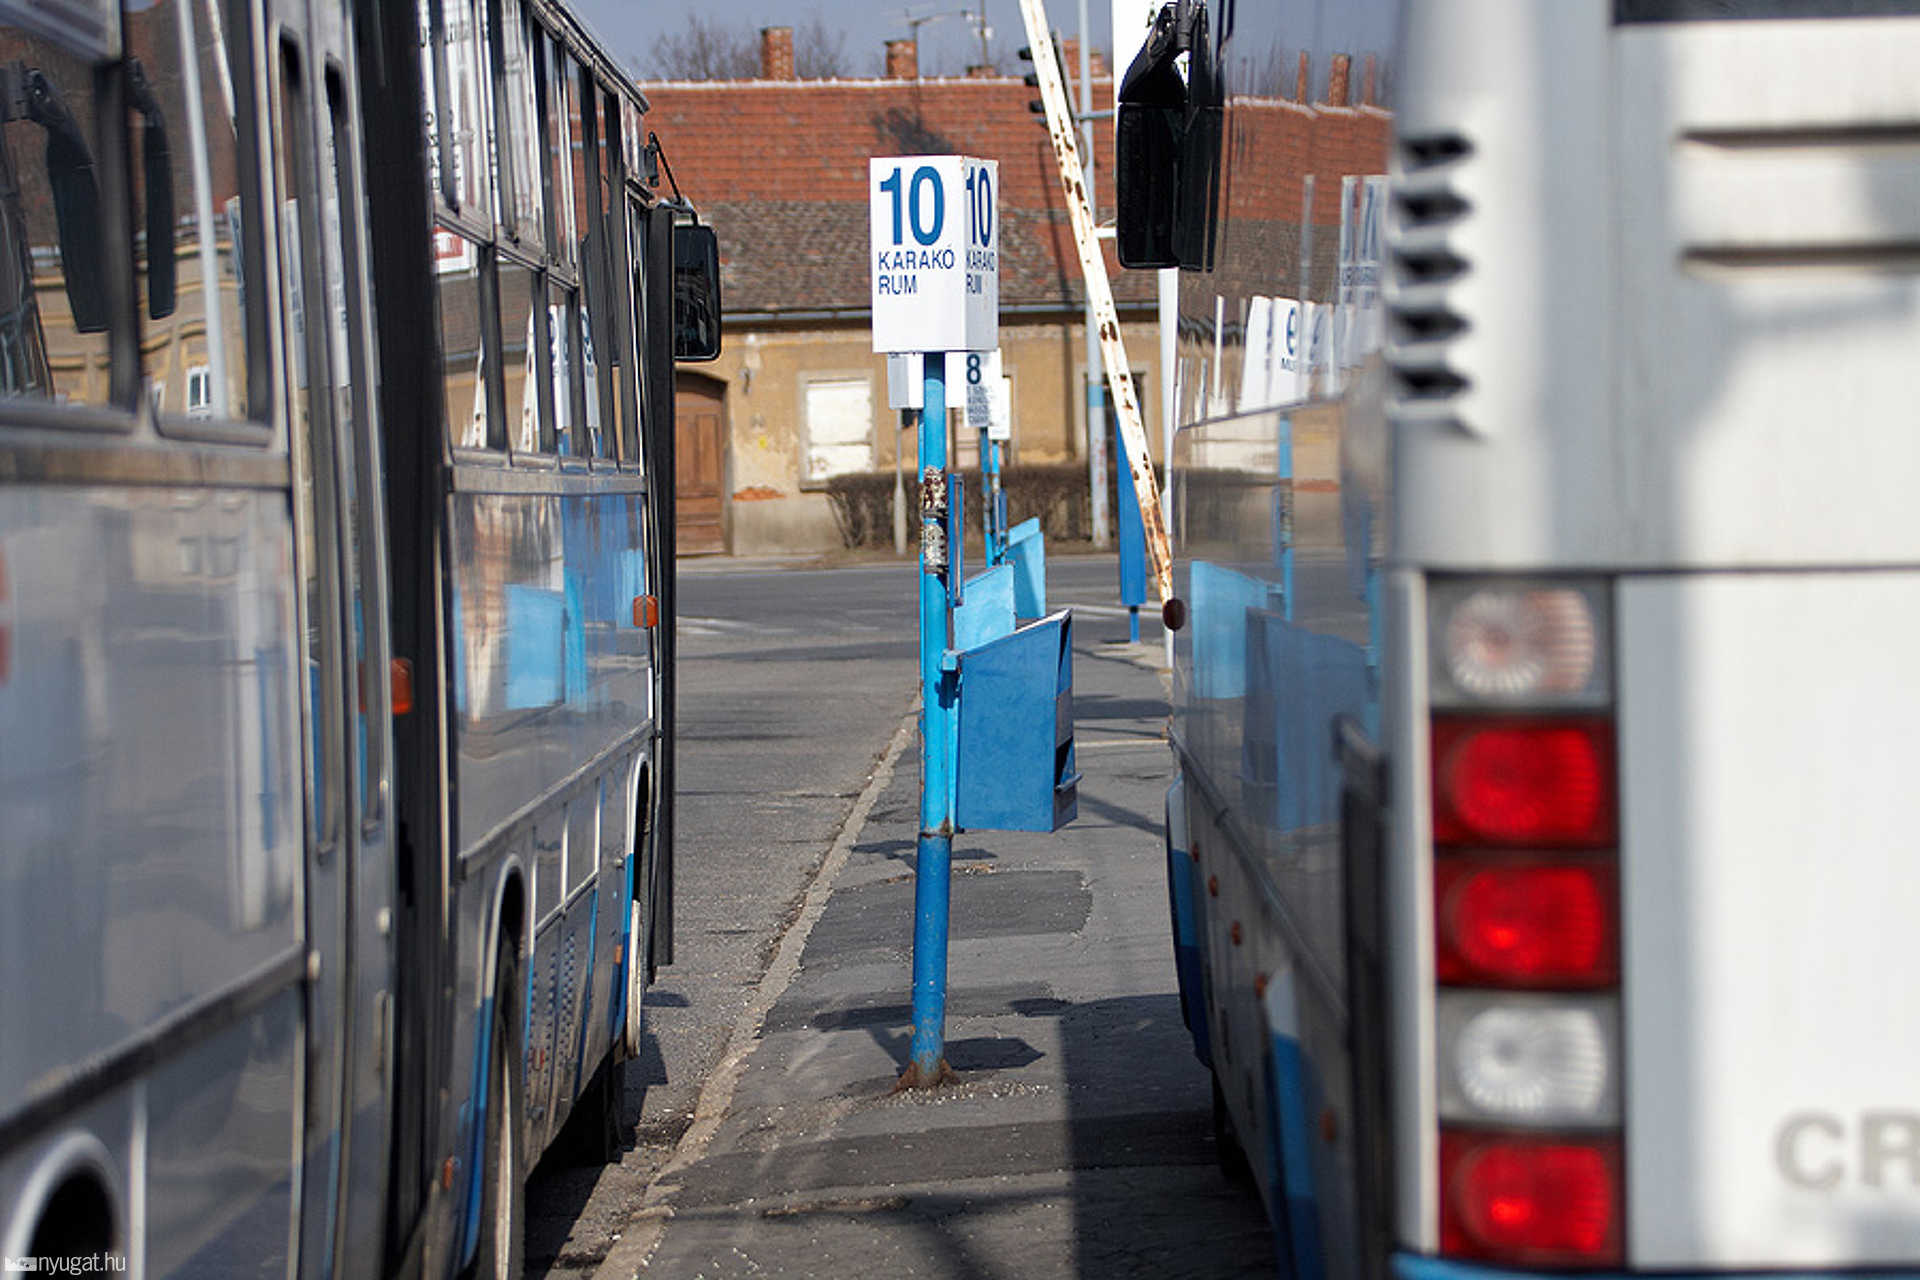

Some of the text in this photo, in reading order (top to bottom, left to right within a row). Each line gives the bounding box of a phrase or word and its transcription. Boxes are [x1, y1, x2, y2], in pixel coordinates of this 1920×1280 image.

[880, 166, 945, 246] 10
[966, 166, 992, 247] 10
[878, 275, 918, 295] RUM
[966, 353, 982, 385] 8
